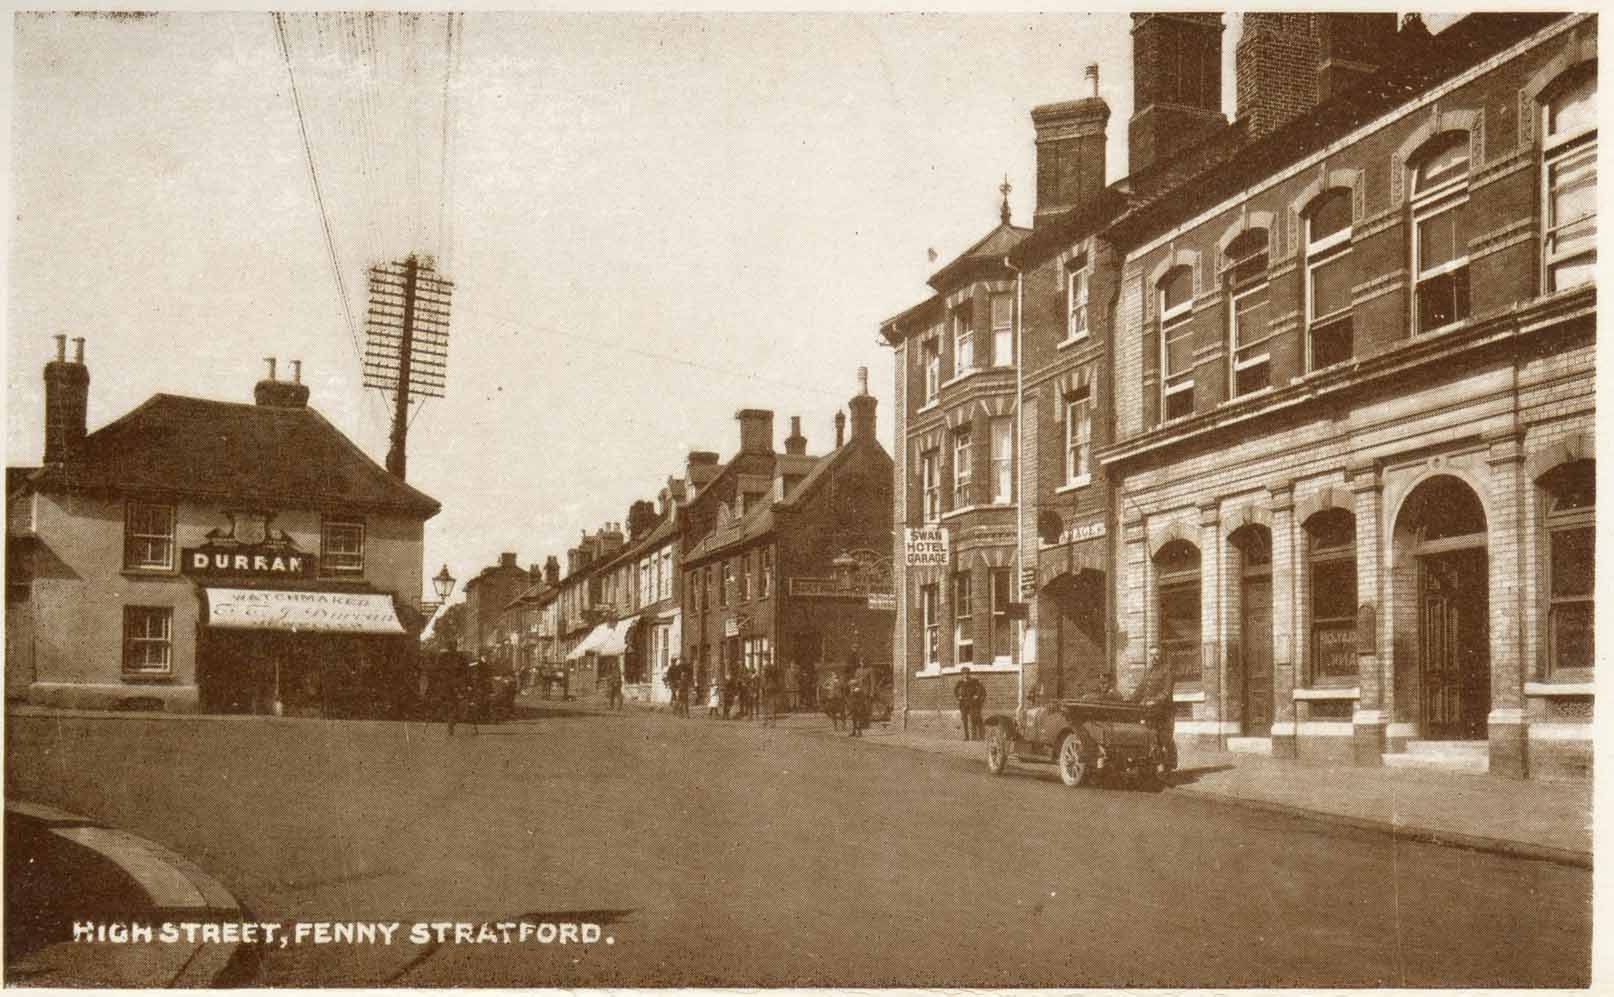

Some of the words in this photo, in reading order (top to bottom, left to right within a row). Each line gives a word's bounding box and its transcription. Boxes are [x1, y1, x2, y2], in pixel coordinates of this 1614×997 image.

[911, 530, 943, 541] SWAN
[907, 542, 947, 552] HOTEL
[193, 552, 303, 572] DURRAN
[907, 553, 947, 563] GARAGE
